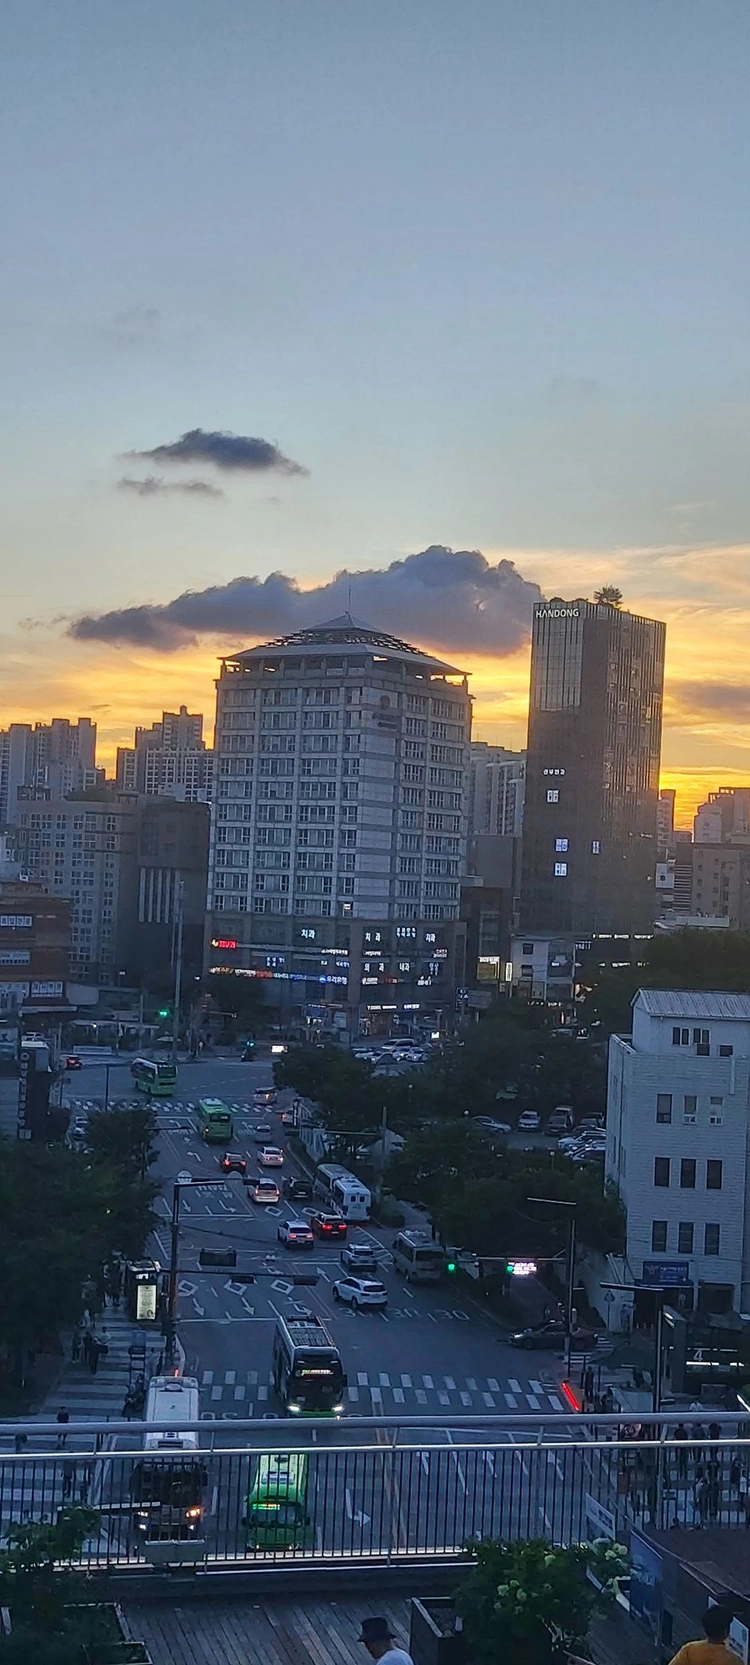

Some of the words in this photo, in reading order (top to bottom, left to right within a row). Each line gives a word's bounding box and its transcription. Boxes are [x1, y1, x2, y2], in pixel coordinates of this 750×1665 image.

[535, 608, 579, 619] HANDONG
[301, 928, 316, 939] 치과
[434, 1308, 471, 1320] 30
